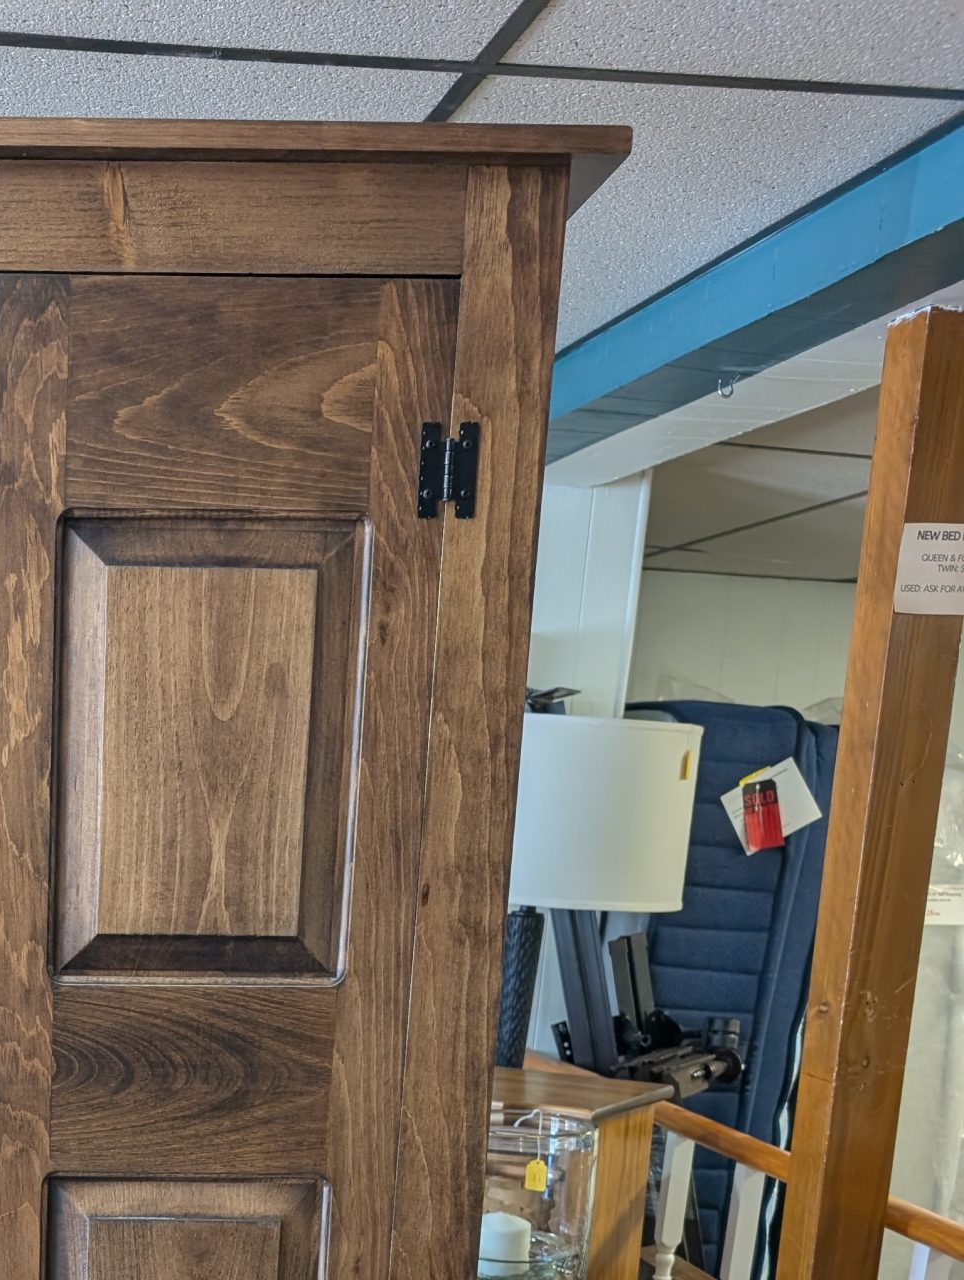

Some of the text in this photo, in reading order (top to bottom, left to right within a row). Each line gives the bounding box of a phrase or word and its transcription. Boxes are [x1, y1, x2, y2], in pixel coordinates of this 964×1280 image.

[917, 530, 941, 541] NEW
[942, 531, 961, 541] BED
[922, 553, 948, 562] QUEEN
[950, 554, 956, 562] &
[923, 584, 939, 593] ASK
[940, 584, 956, 593] FOR
[744, 790, 775, 808] SOLD
